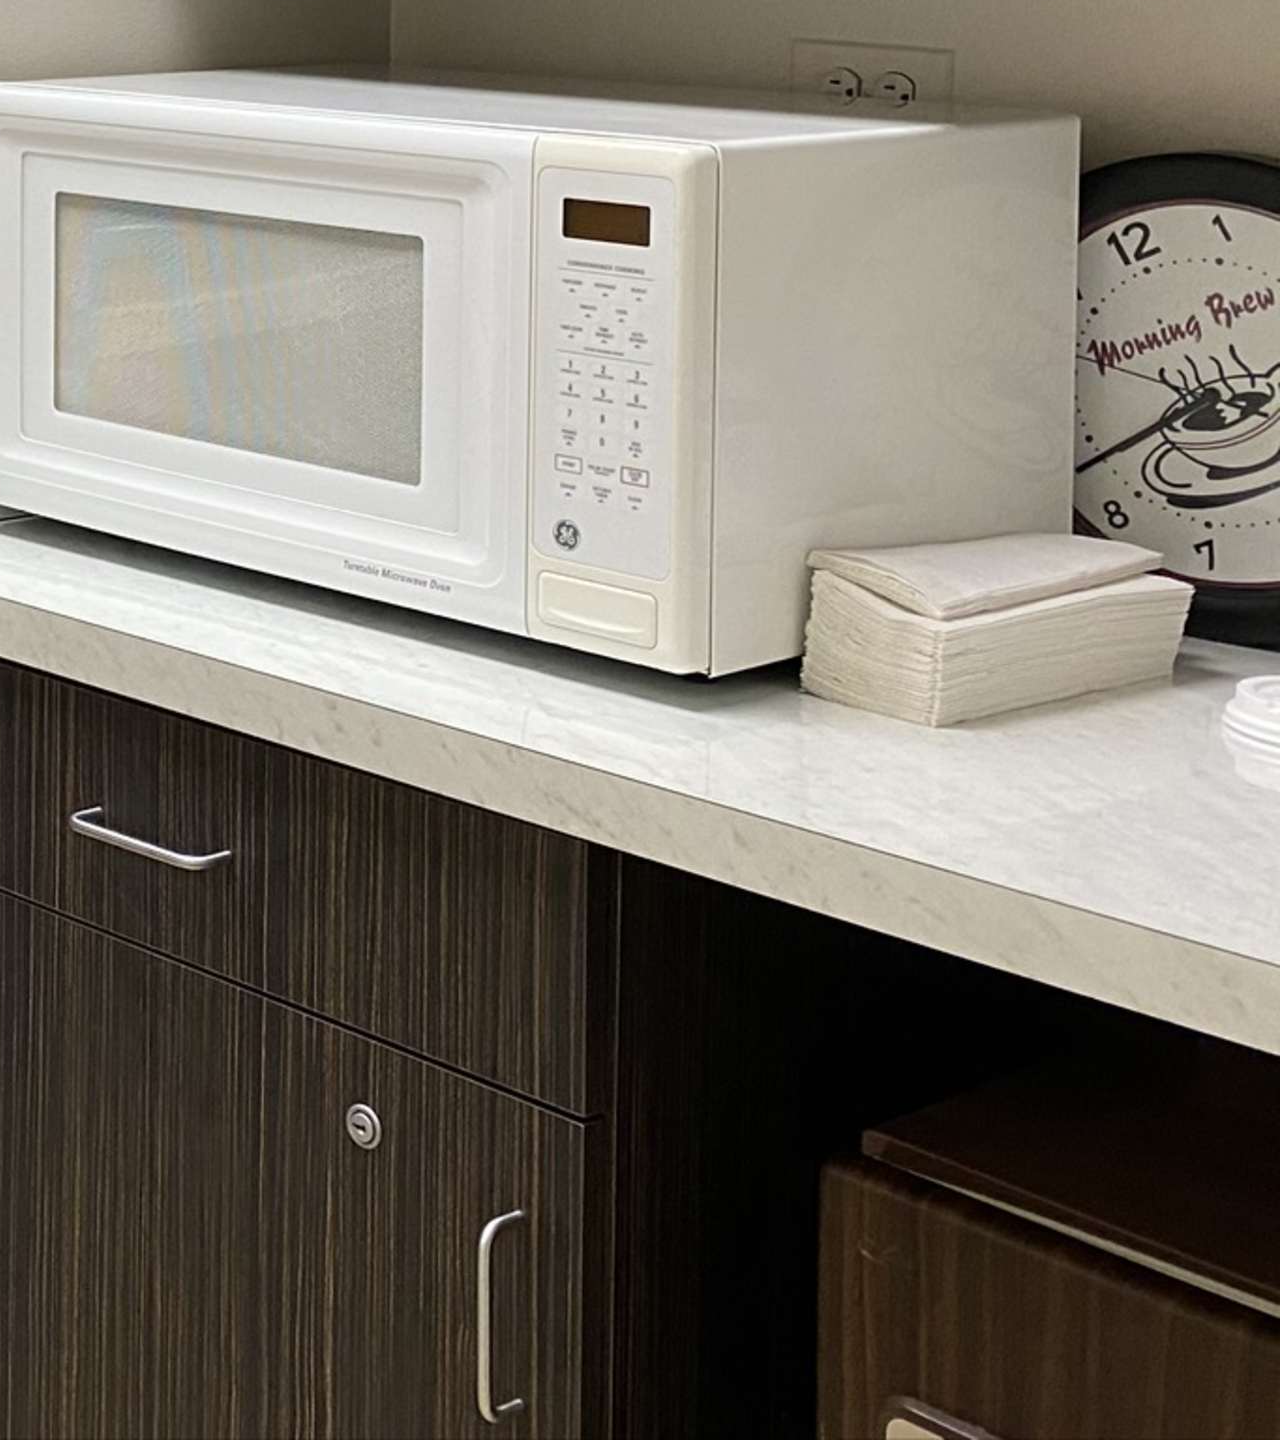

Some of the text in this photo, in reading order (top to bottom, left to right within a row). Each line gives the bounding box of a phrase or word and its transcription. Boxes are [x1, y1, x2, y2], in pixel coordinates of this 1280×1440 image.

[1106, 221, 1162, 267] 12
[1211, 213, 1233, 243] 1
[1087, 287, 1276, 376] Morning Brew
[1102, 499, 1130, 530] 8
[1192, 539, 1216, 571] 7
